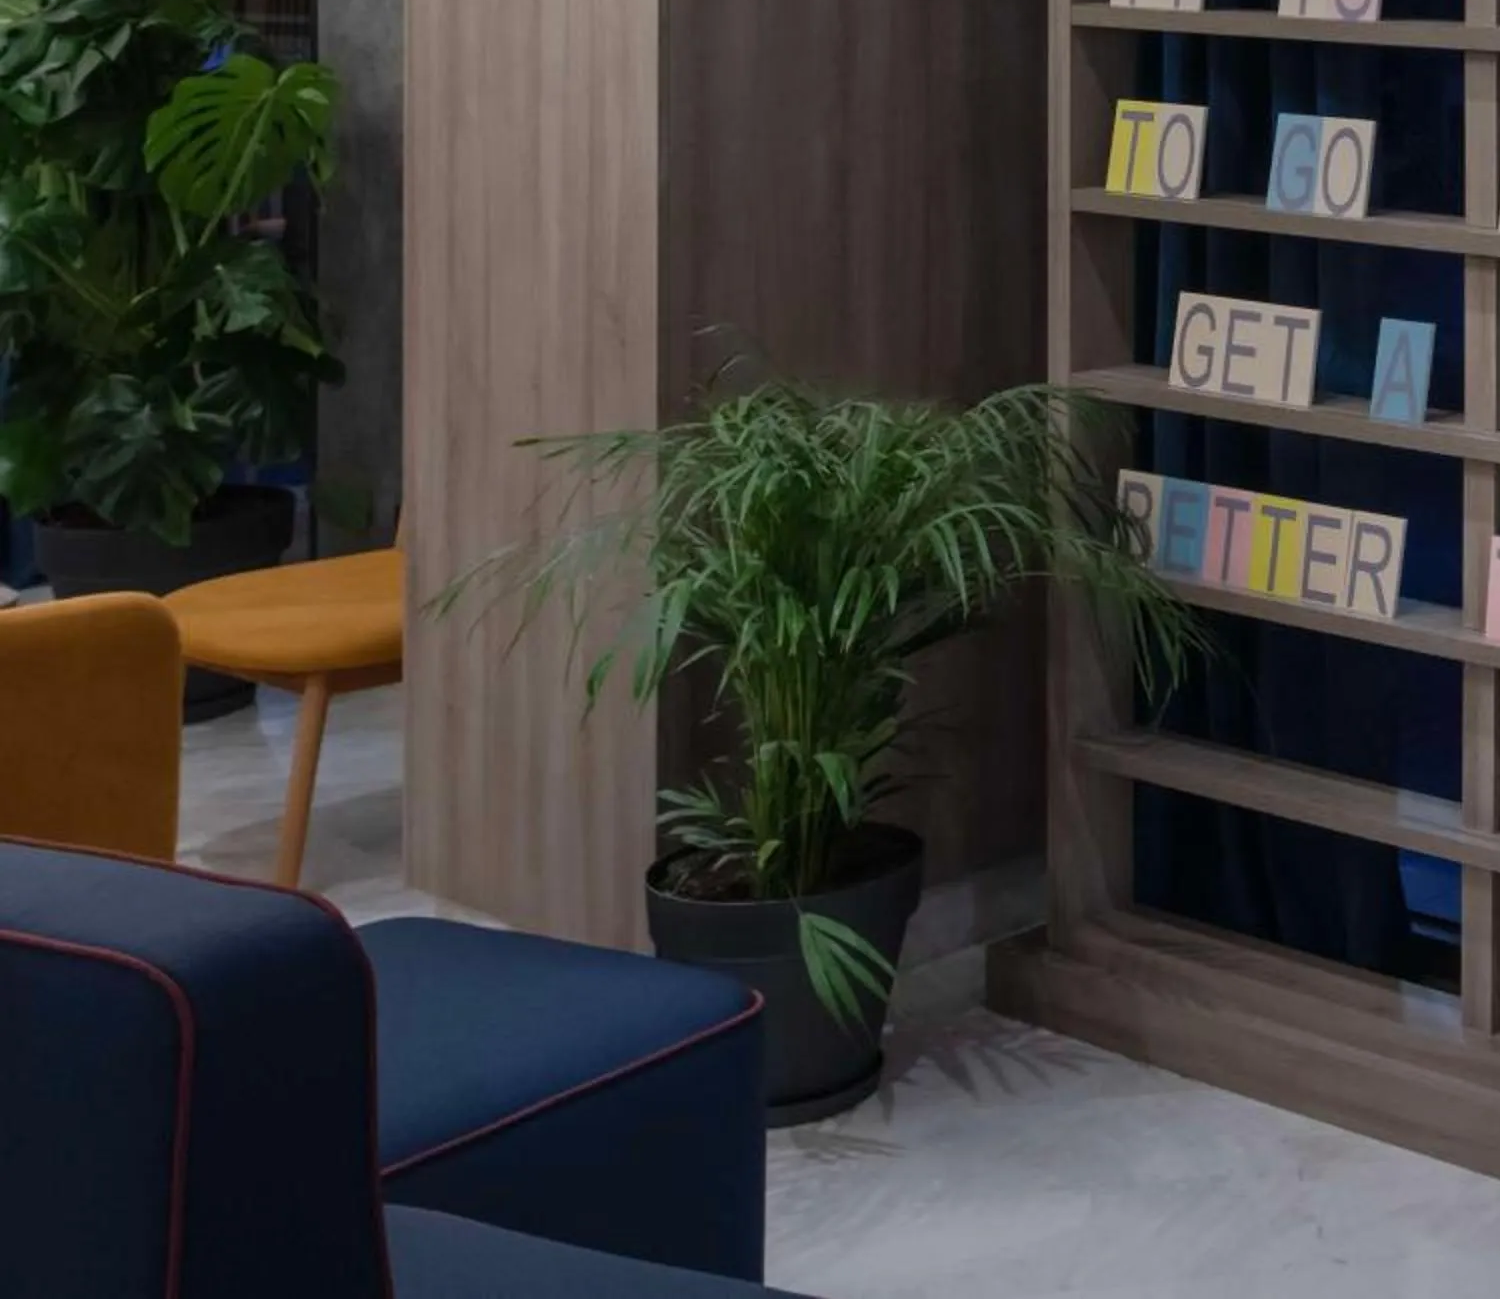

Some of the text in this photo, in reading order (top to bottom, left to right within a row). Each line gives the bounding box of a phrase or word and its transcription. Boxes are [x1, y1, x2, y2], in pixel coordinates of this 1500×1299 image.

[1121, 111, 1196, 199] TO
[1275, 127, 1364, 218] GO
[1177, 302, 1310, 402] GET
[1374, 330, 1422, 422] A
[1120, 480, 1393, 615] BETTER
